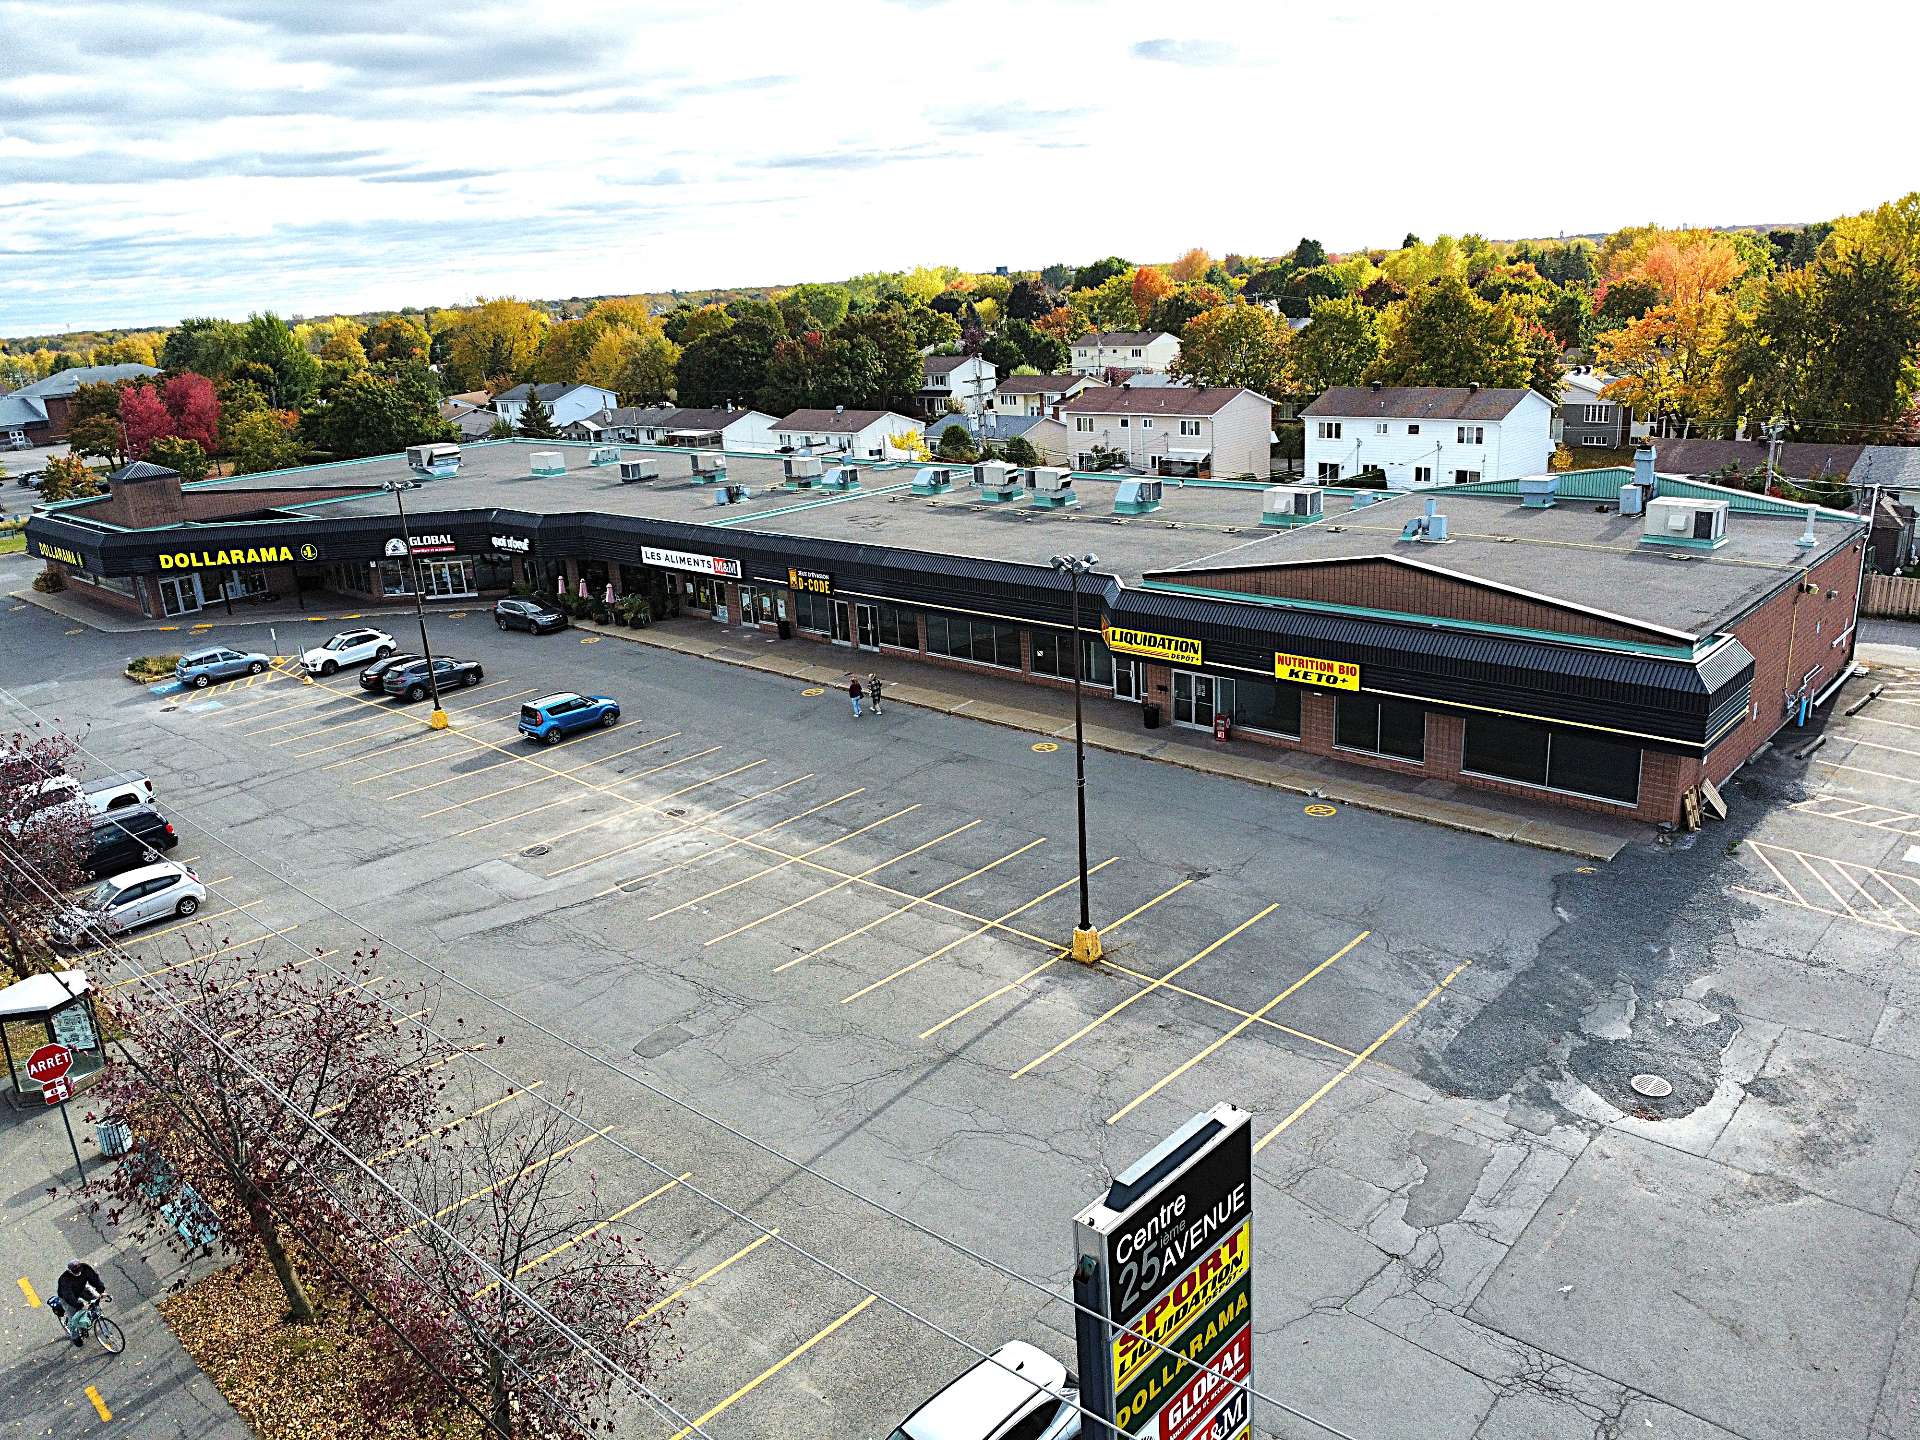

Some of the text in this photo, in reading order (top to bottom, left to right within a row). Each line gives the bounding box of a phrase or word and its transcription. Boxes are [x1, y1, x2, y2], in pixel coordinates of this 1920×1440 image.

[409, 534, 455, 546] GLOBAL
[39, 542, 78, 566] DOLLARAMA
[159, 546, 294, 569] DOLLARAMA
[644, 550, 737, 575] LES ALIMENTS M&M
[798, 576, 831, 594] D-CODE
[1111, 629, 1200, 655] LIQUIDATION
[1277, 654, 1357, 677] NUTRITION BIO
[30, 1051, 69, 1076] ARRÊT
[1116, 1194, 1186, 1264] Centre
[1118, 1241, 1160, 1313] 25
[1161, 1182, 1245, 1277] AVENUE
[1119, 1225, 1244, 1358] SPORT
[1119, 1249, 1244, 1377] LIQUIDATION
[1116, 1291, 1249, 1430] DOLLARAMA
[1168, 1342, 1245, 1431] GLOBAL
